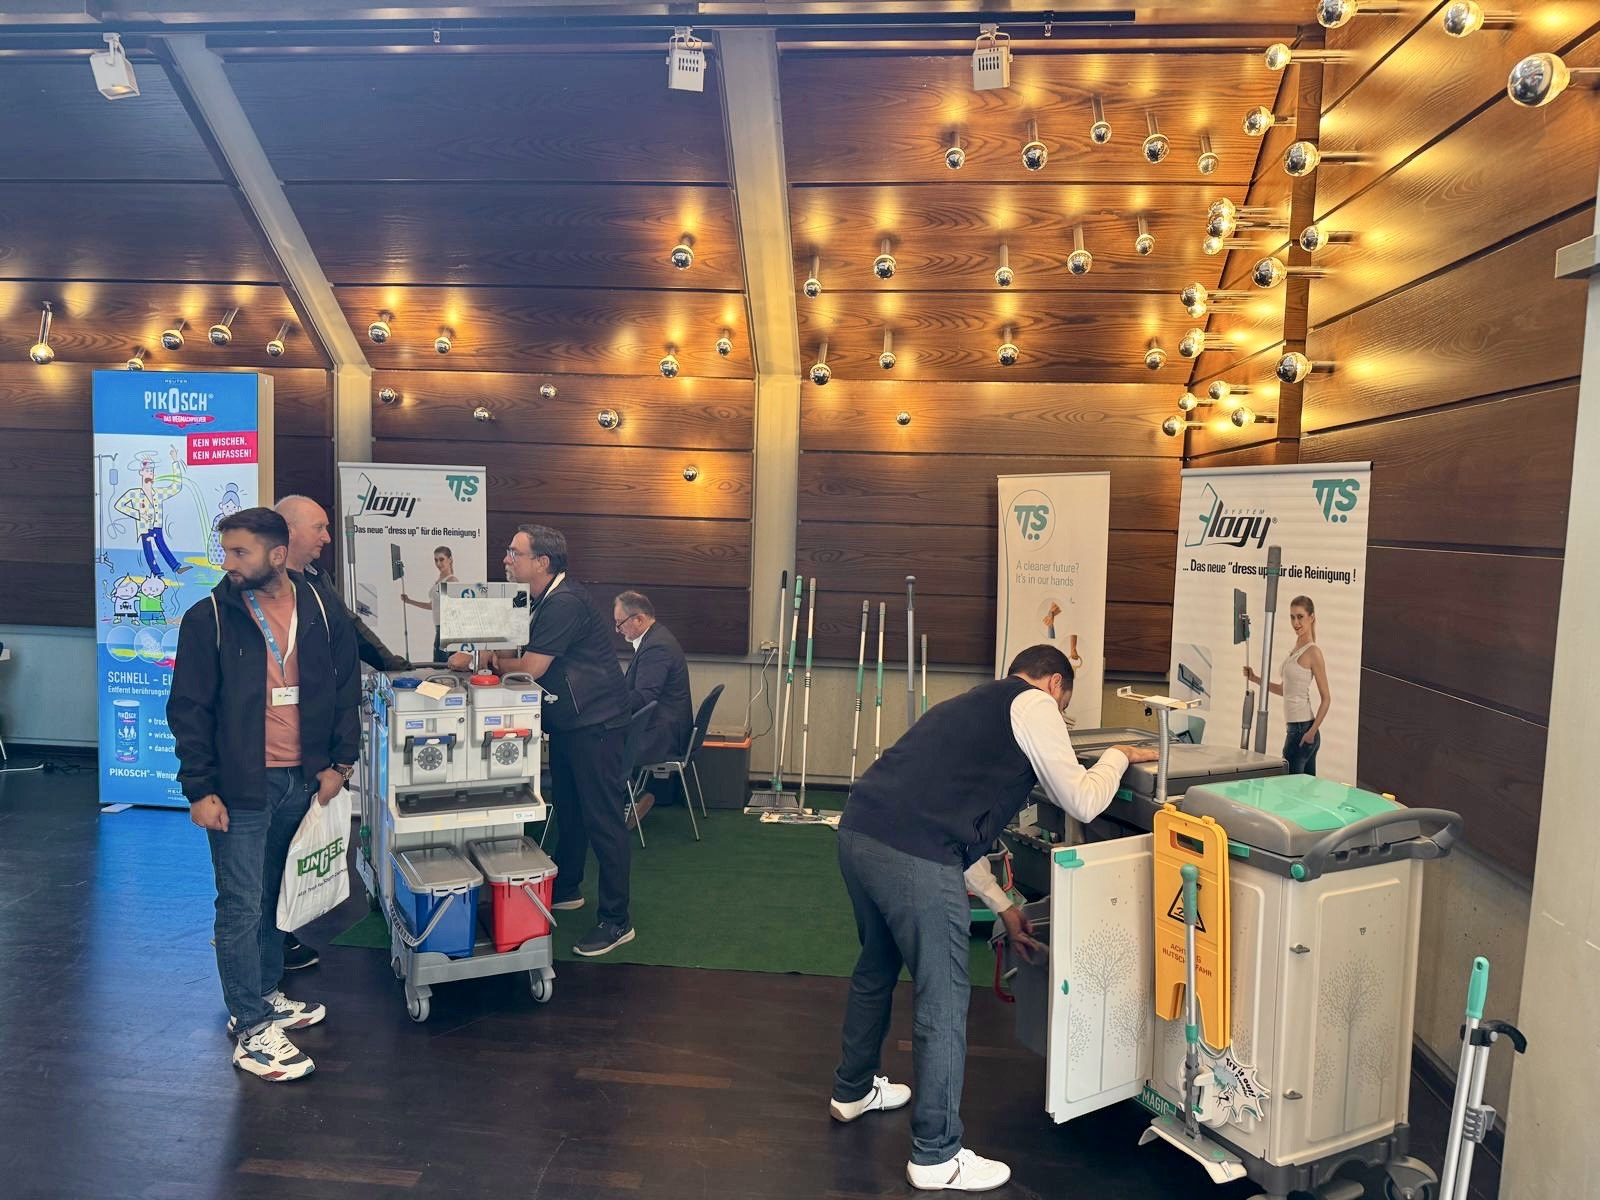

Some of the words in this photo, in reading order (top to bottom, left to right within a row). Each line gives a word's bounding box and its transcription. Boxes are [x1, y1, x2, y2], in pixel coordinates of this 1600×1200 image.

[192, 438, 210, 448] KEIN
[192, 450, 210, 460] KEIN
[211, 448, 252, 459] ANFASSEN!
[1224, 508, 1266, 516] SYSTEM
[354, 524, 366, 534] Das
[431, 526, 442, 536] die
[442, 527, 477, 539] Reinigung
[1015, 560, 1022, 570] A
[1023, 560, 1051, 572] cleaner
[1052, 561, 1080, 573] future?
[1190, 558, 1206, 572] Das
[1207, 563, 1226, 573] neue
[1288, 564, 1303, 578] die
[1304, 565, 1351, 584] Reinigung
[1015, 573, 1026, 584] It's
[1028, 573, 1036, 584] in
[1037, 576, 1049, 585] our
[1050, 575, 1074, 587] hands
[107, 671, 150, 685] SCHNELL
[107, 685, 131, 694] Entfernt
[1170, 943, 1202, 964] ACHG
[1162, 947, 1212, 977] RUTSCFAHR
[1225, 1057, 1238, 1071] Try
[1142, 1090, 1170, 1115] MAGIC
